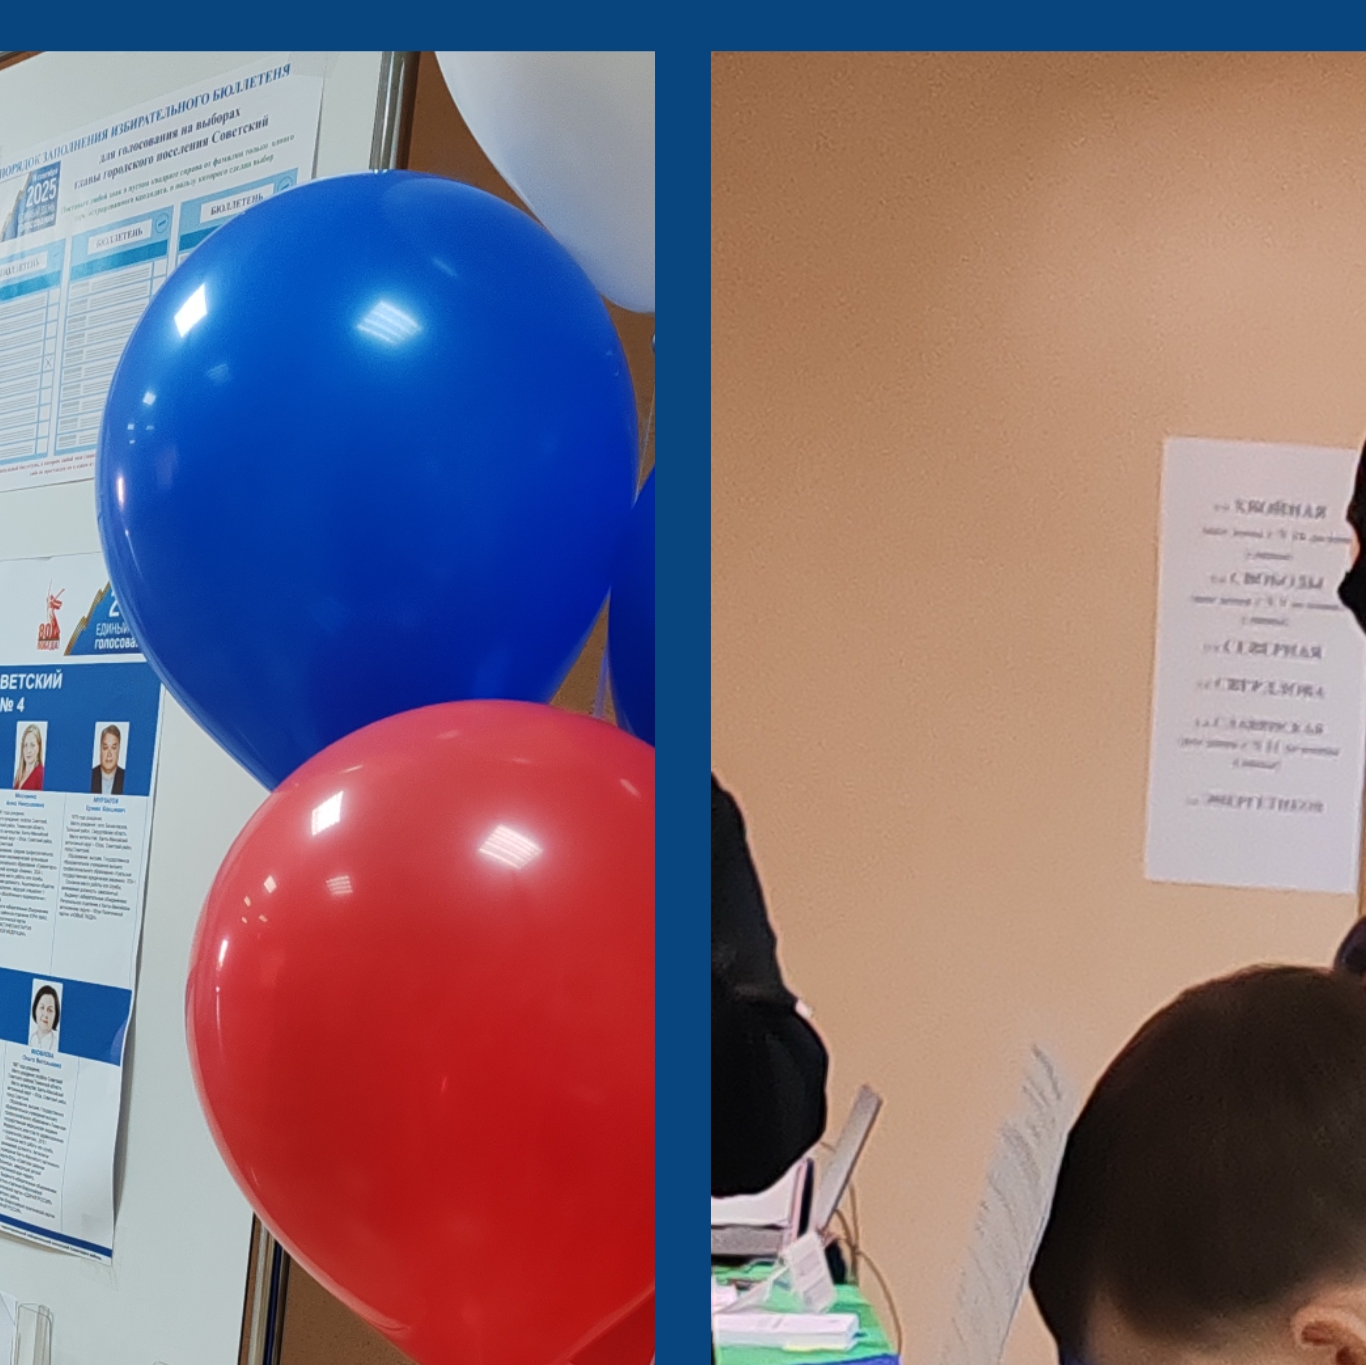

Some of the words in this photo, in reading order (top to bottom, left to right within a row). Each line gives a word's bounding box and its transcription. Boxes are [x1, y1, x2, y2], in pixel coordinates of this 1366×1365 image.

[0, 153, 40, 179] ПОРЯДОК
[42, 129, 107, 164] ЗАПОЛНЕНИЯ
[110, 93, 209, 139] ИЗБИРАТЕЛЬНОГО
[212, 64, 290, 103] БЮЛЛЕТЕНЯ
[99, 150, 115, 165] для
[118, 128, 178, 156] голосования
[181, 123, 192, 136] на
[195, 105, 240, 133] выборах
[74, 172, 100, 190] главы
[102, 154, 153, 182] городского
[156, 136, 208, 163] поселения
[211, 112, 269, 144] Советский
[26, 178, 57, 208] 2025
[95, 637, 138, 650] голосова
[0, 697, 13, 712] №
[16, 697, 25, 712] 4
